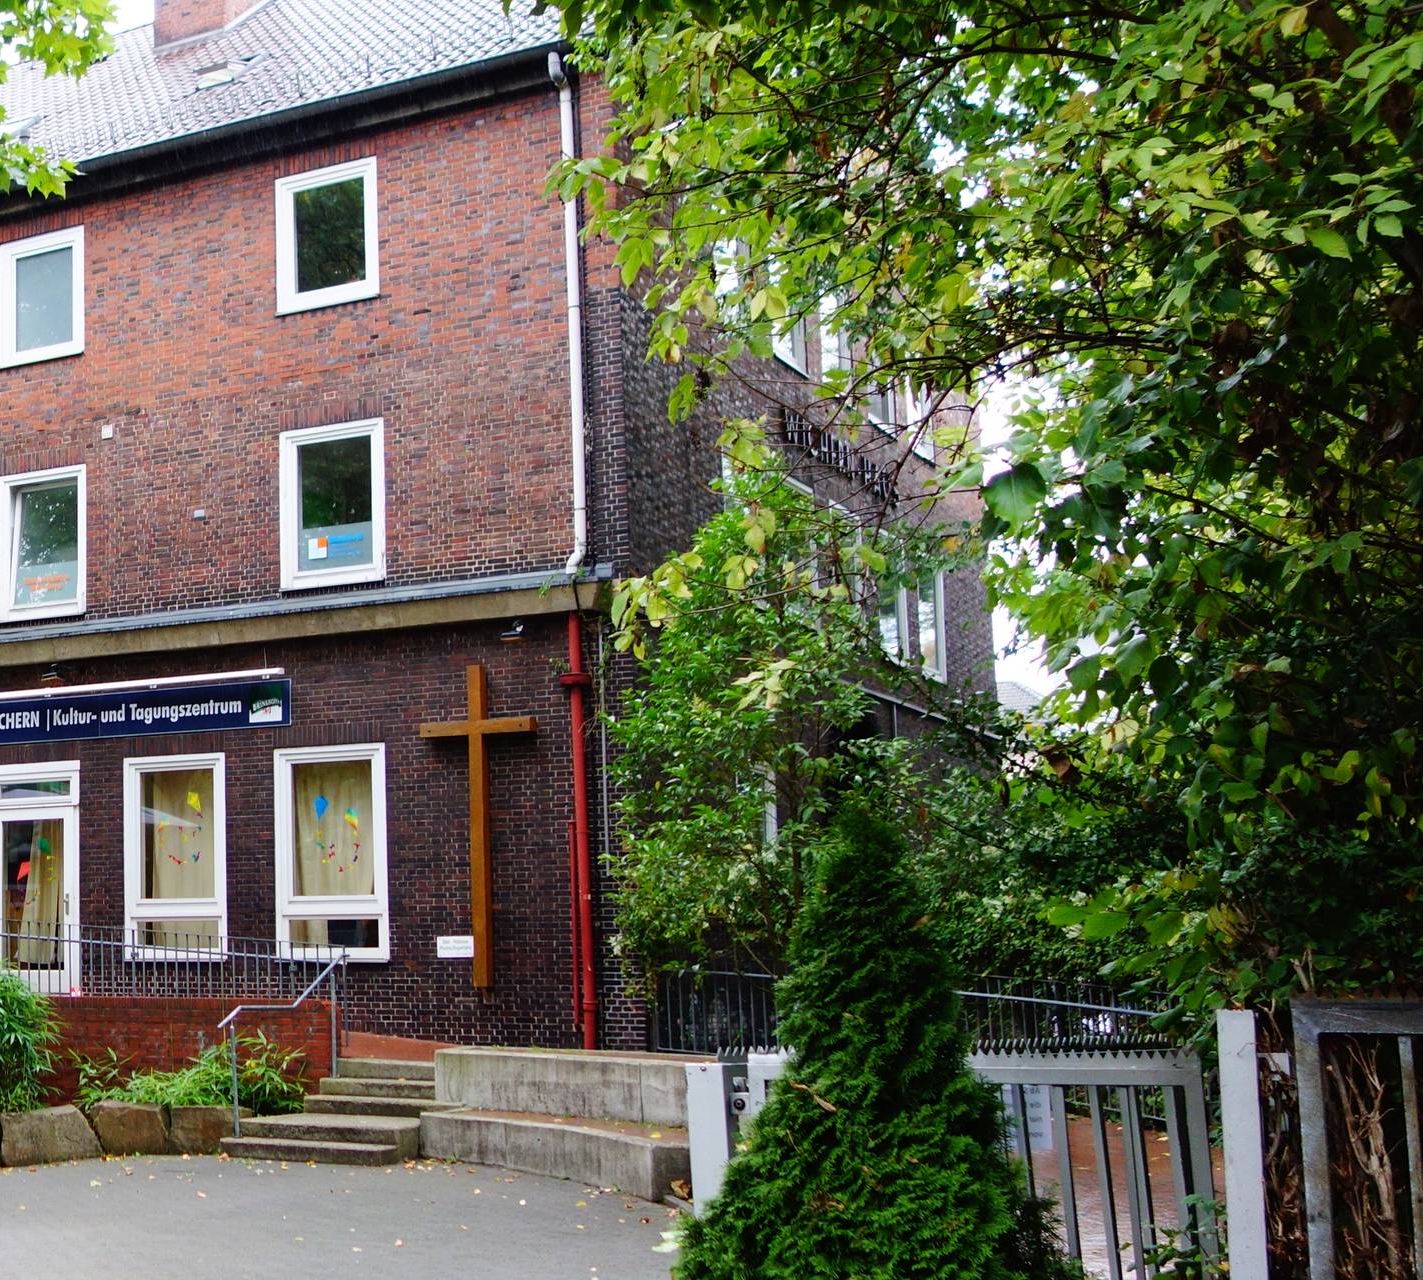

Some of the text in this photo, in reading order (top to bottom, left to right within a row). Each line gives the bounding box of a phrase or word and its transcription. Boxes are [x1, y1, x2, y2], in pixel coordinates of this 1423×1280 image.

[52, 707, 97, 726] Kultur-
[100, 703, 126, 723] und
[129, 699, 242, 725] Tagungszentrum
